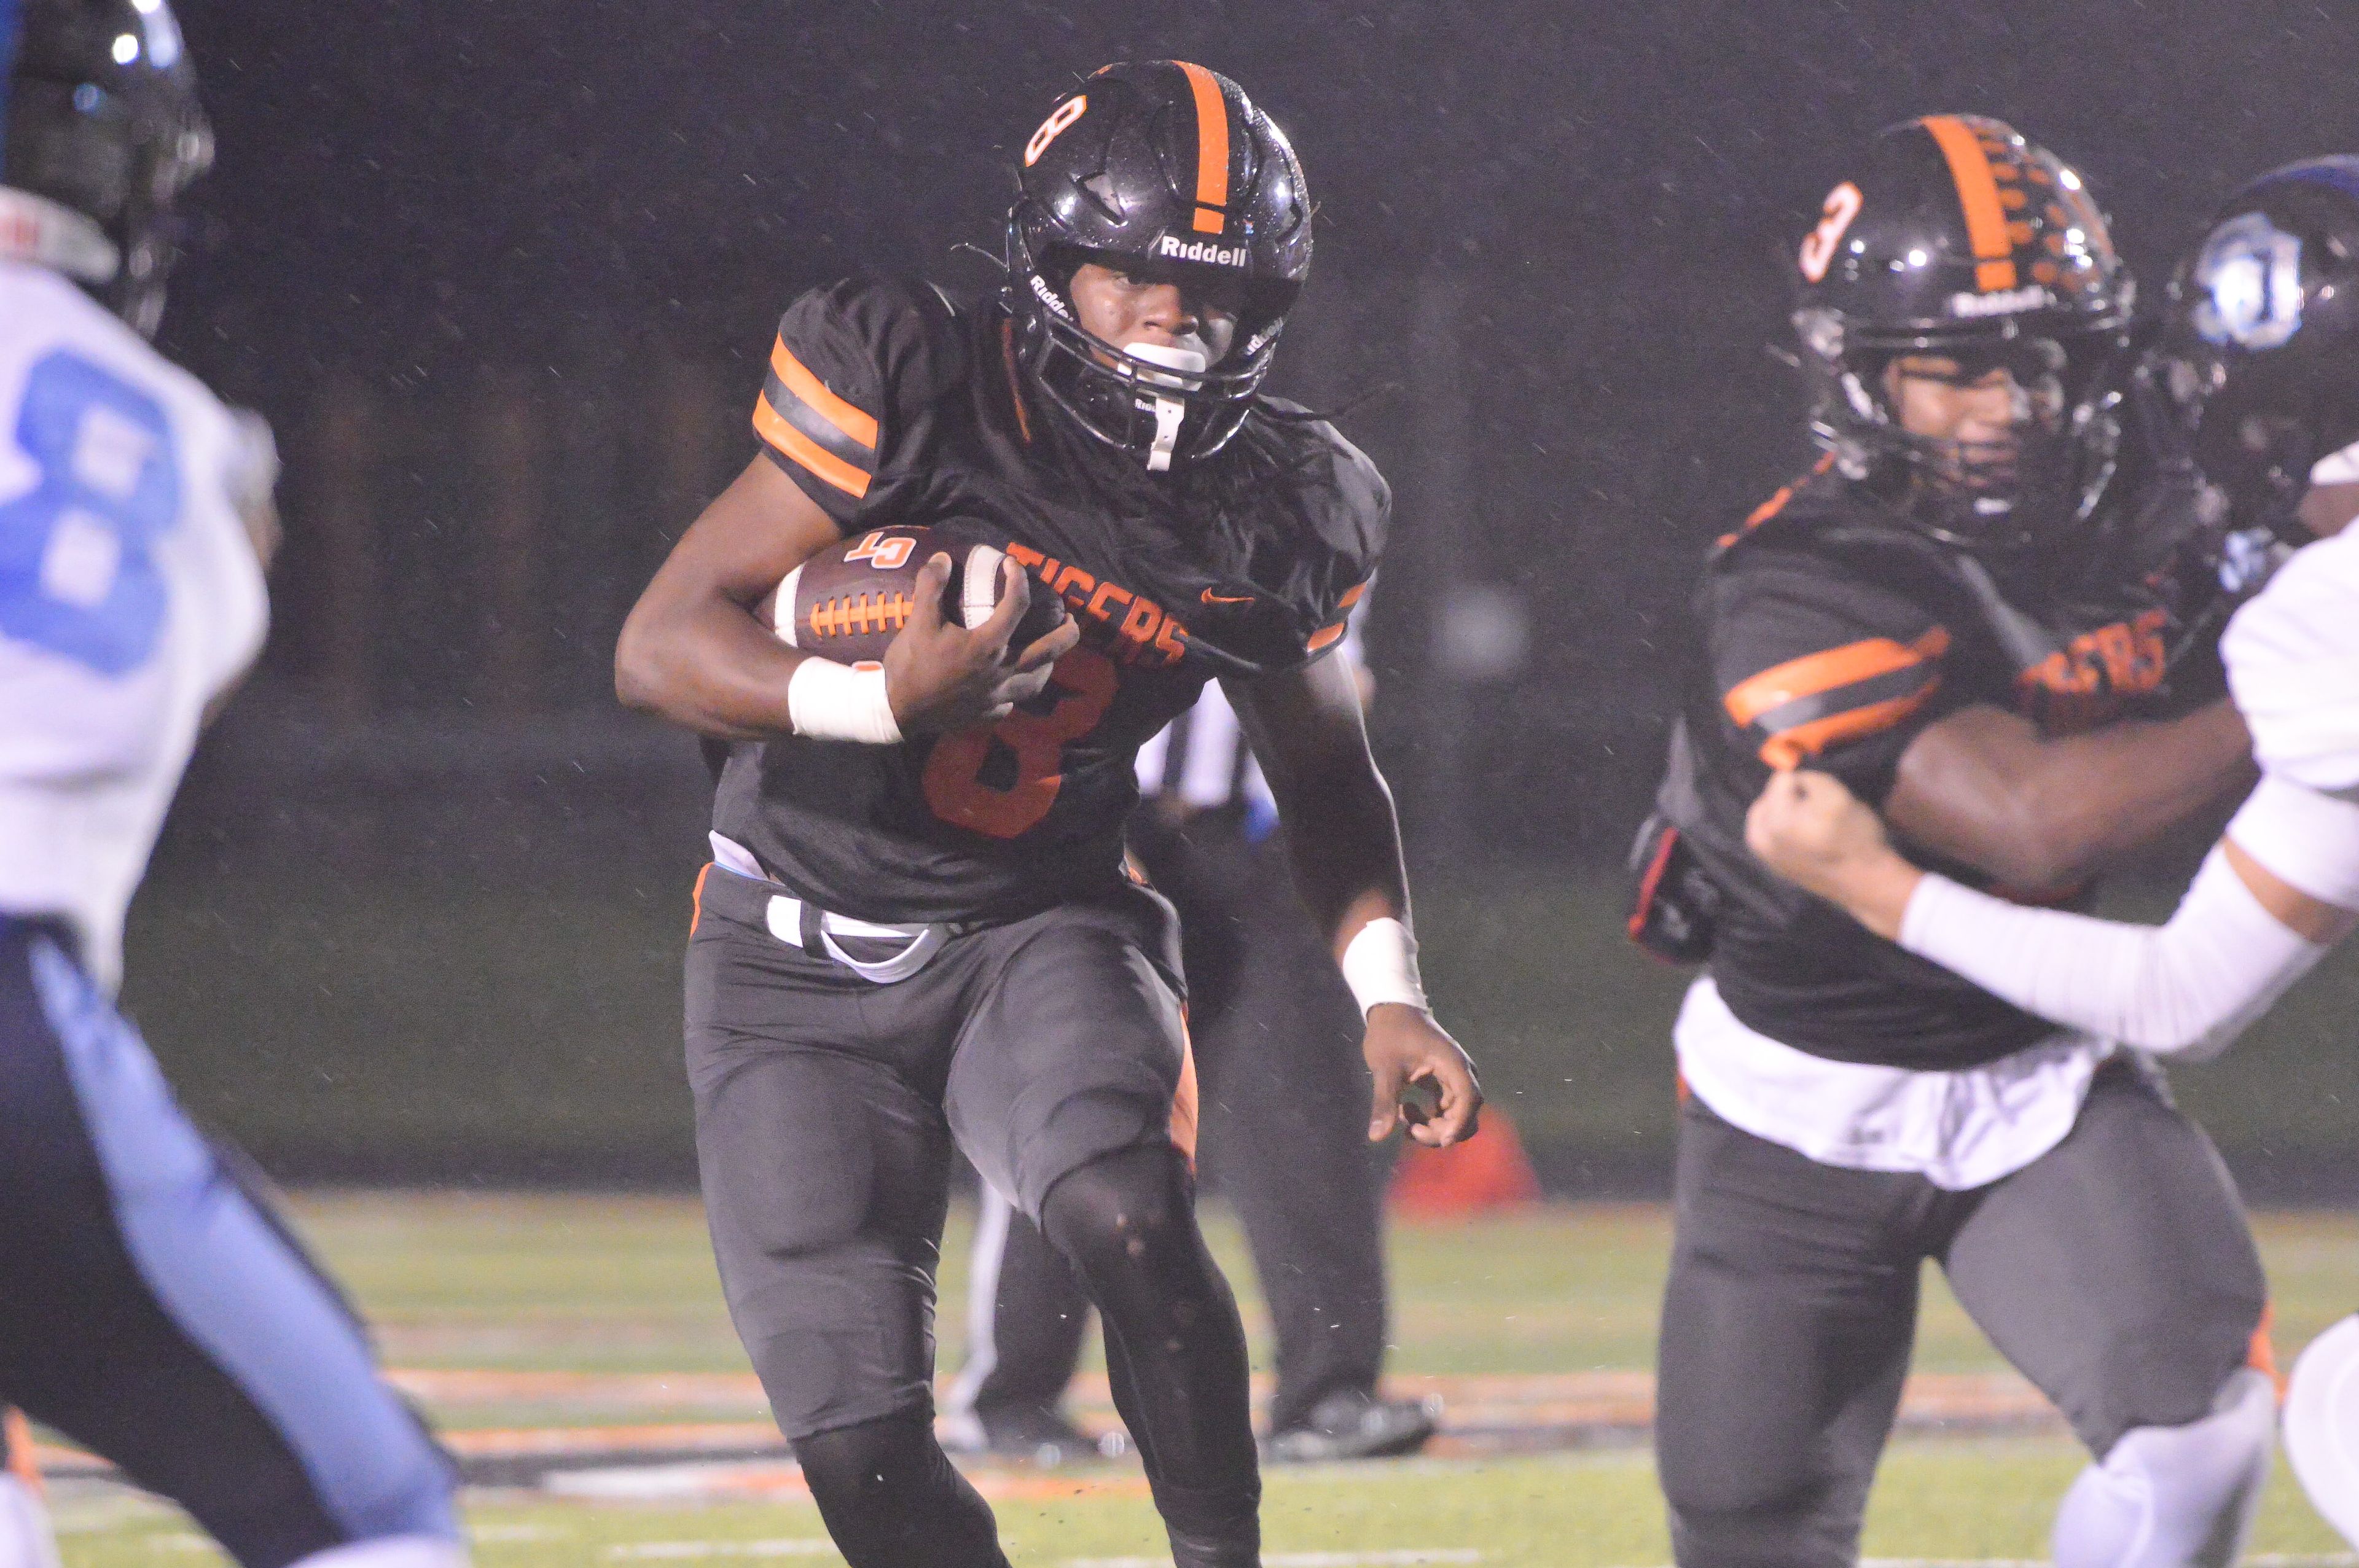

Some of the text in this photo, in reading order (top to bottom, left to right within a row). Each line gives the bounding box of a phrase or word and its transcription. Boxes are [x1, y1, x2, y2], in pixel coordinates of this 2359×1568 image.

[1023, 95, 1087, 167] 8
[1160, 235, 1246, 267] Riddell
[1798, 181, 1864, 283] 3
[925, 646, 1119, 840] 8
